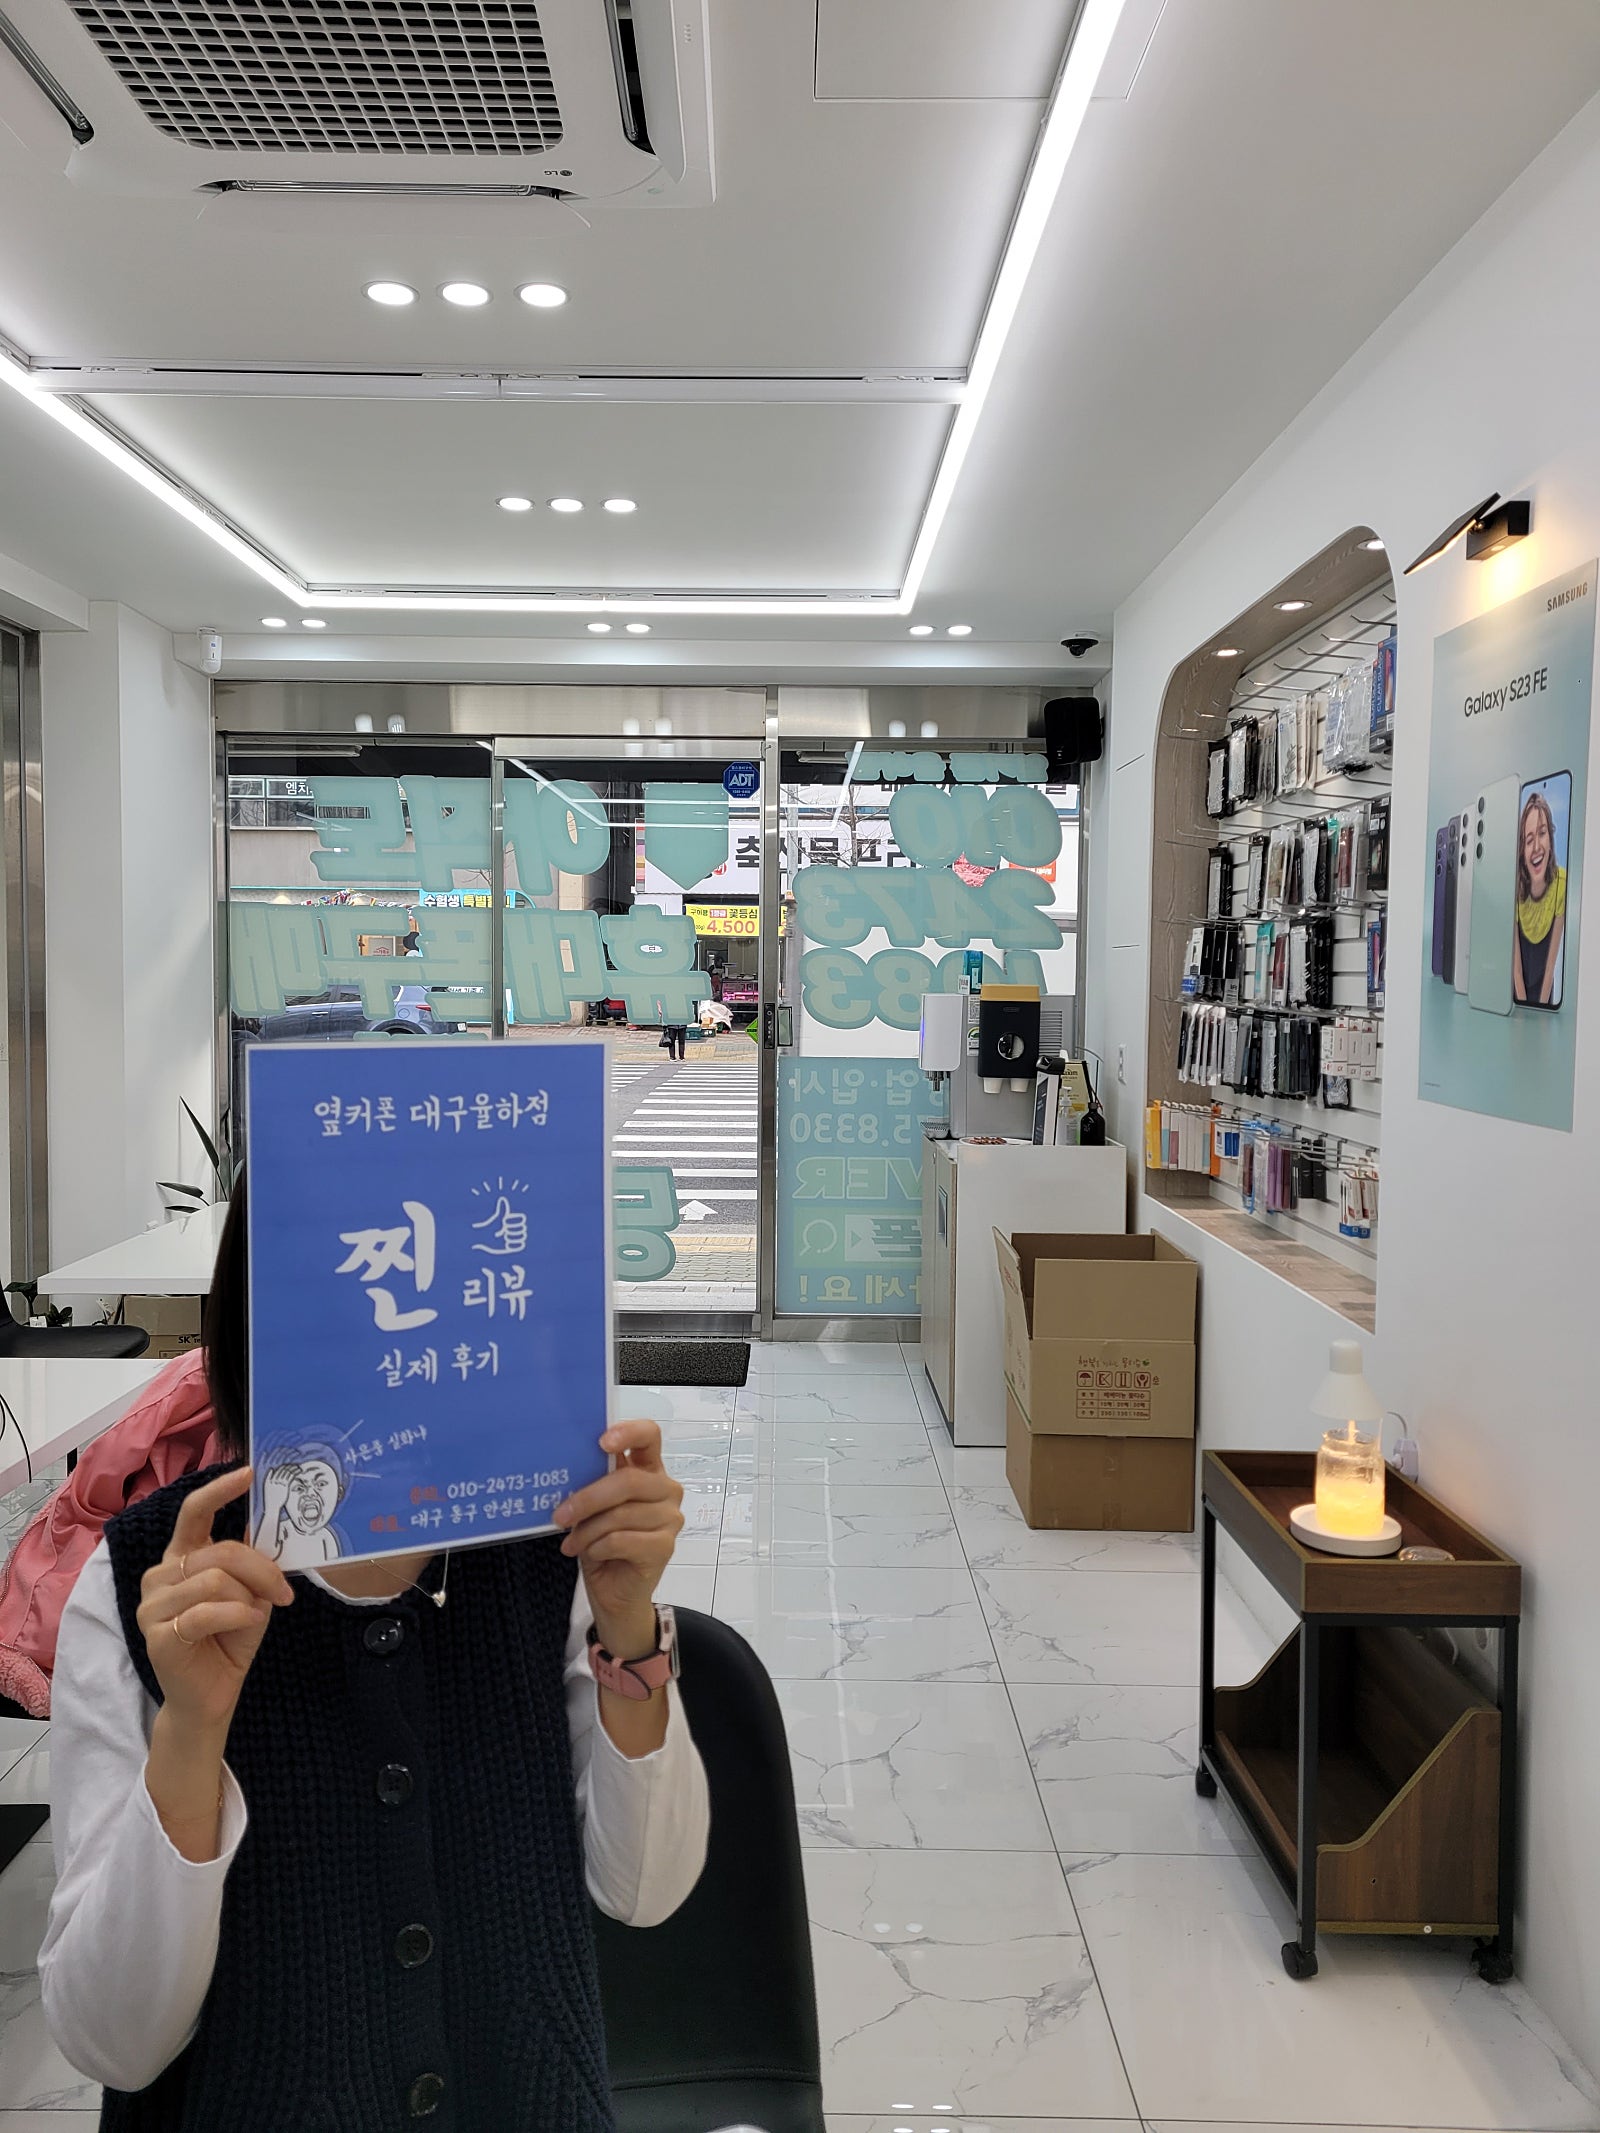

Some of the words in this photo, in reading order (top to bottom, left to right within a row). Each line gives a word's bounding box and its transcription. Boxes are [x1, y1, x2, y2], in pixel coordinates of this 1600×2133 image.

[1547, 582, 1588, 612] SAMSUNG
[1464, 686, 1508, 717] Galaxy
[1509, 674, 1531, 702] S23
[1533, 667, 1548, 693] FE
[285, 780, 313, 796] 엠치
[729, 773, 755, 787] ADT
[463, 894, 511, 908] 특별!
[729, 908, 758, 918] 꽃등심
[706, 919, 756, 933] 4,500
[314, 1096, 396, 1136] 옆커폰
[409, 1089, 549, 1133] 대구율하점
[334, 1201, 438, 1331] 찐
[463, 1264, 533, 1321] 리뷰
[178, 1336, 191, 1344] SK
[376, 1347, 438, 1387] 실제
[451, 1341, 498, 1381] 후기
[447, 1469, 569, 1499] 010-2473-1083
[411, 1508, 444, 1529] 대구
